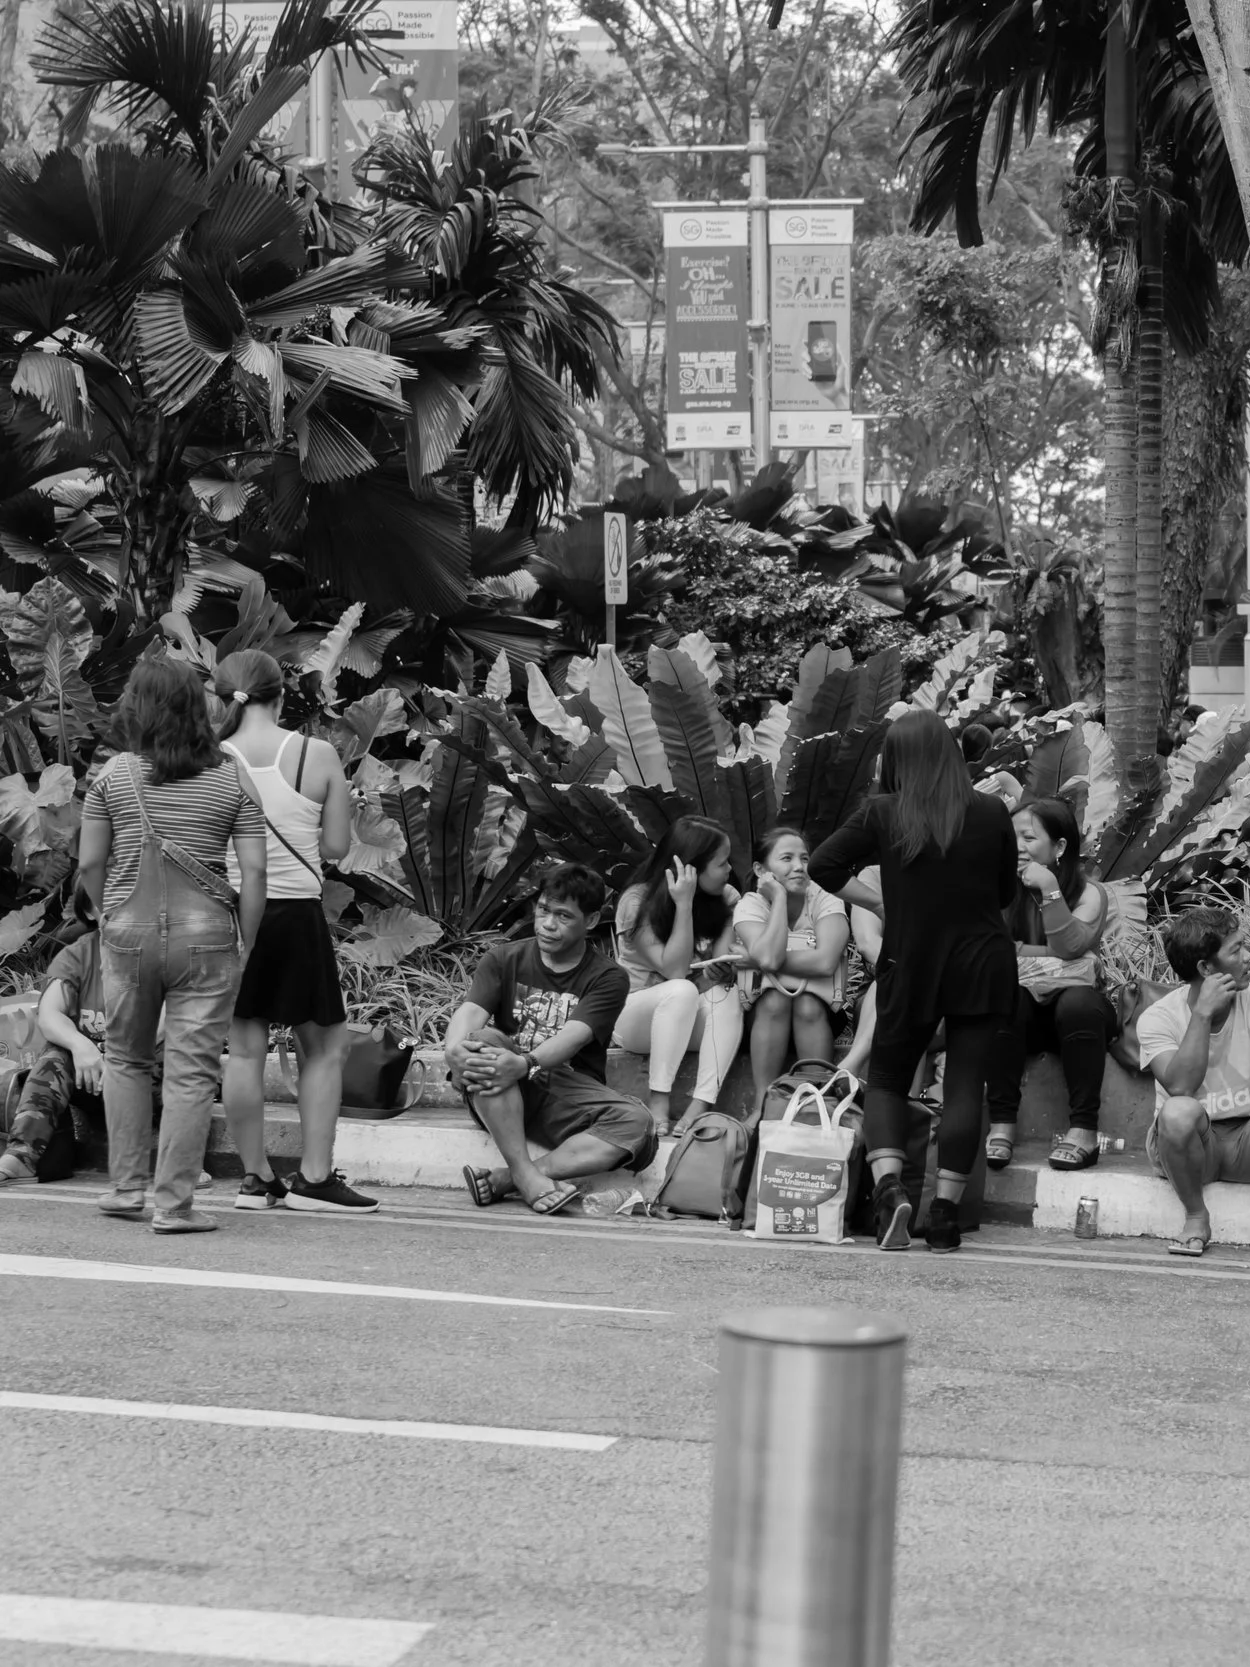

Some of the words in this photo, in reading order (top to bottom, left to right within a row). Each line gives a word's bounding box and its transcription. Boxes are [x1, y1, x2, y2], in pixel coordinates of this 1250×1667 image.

[398, 21, 422, 29] Made
[775, 276, 845, 300] SALE
[679, 368, 736, 389] SALE
[775, 1168, 795, 1181] Enjoy
[811, 1174, 825, 1182] and
[784, 1177, 820, 1189] Unlimited
[820, 1181, 838, 1190] Data
